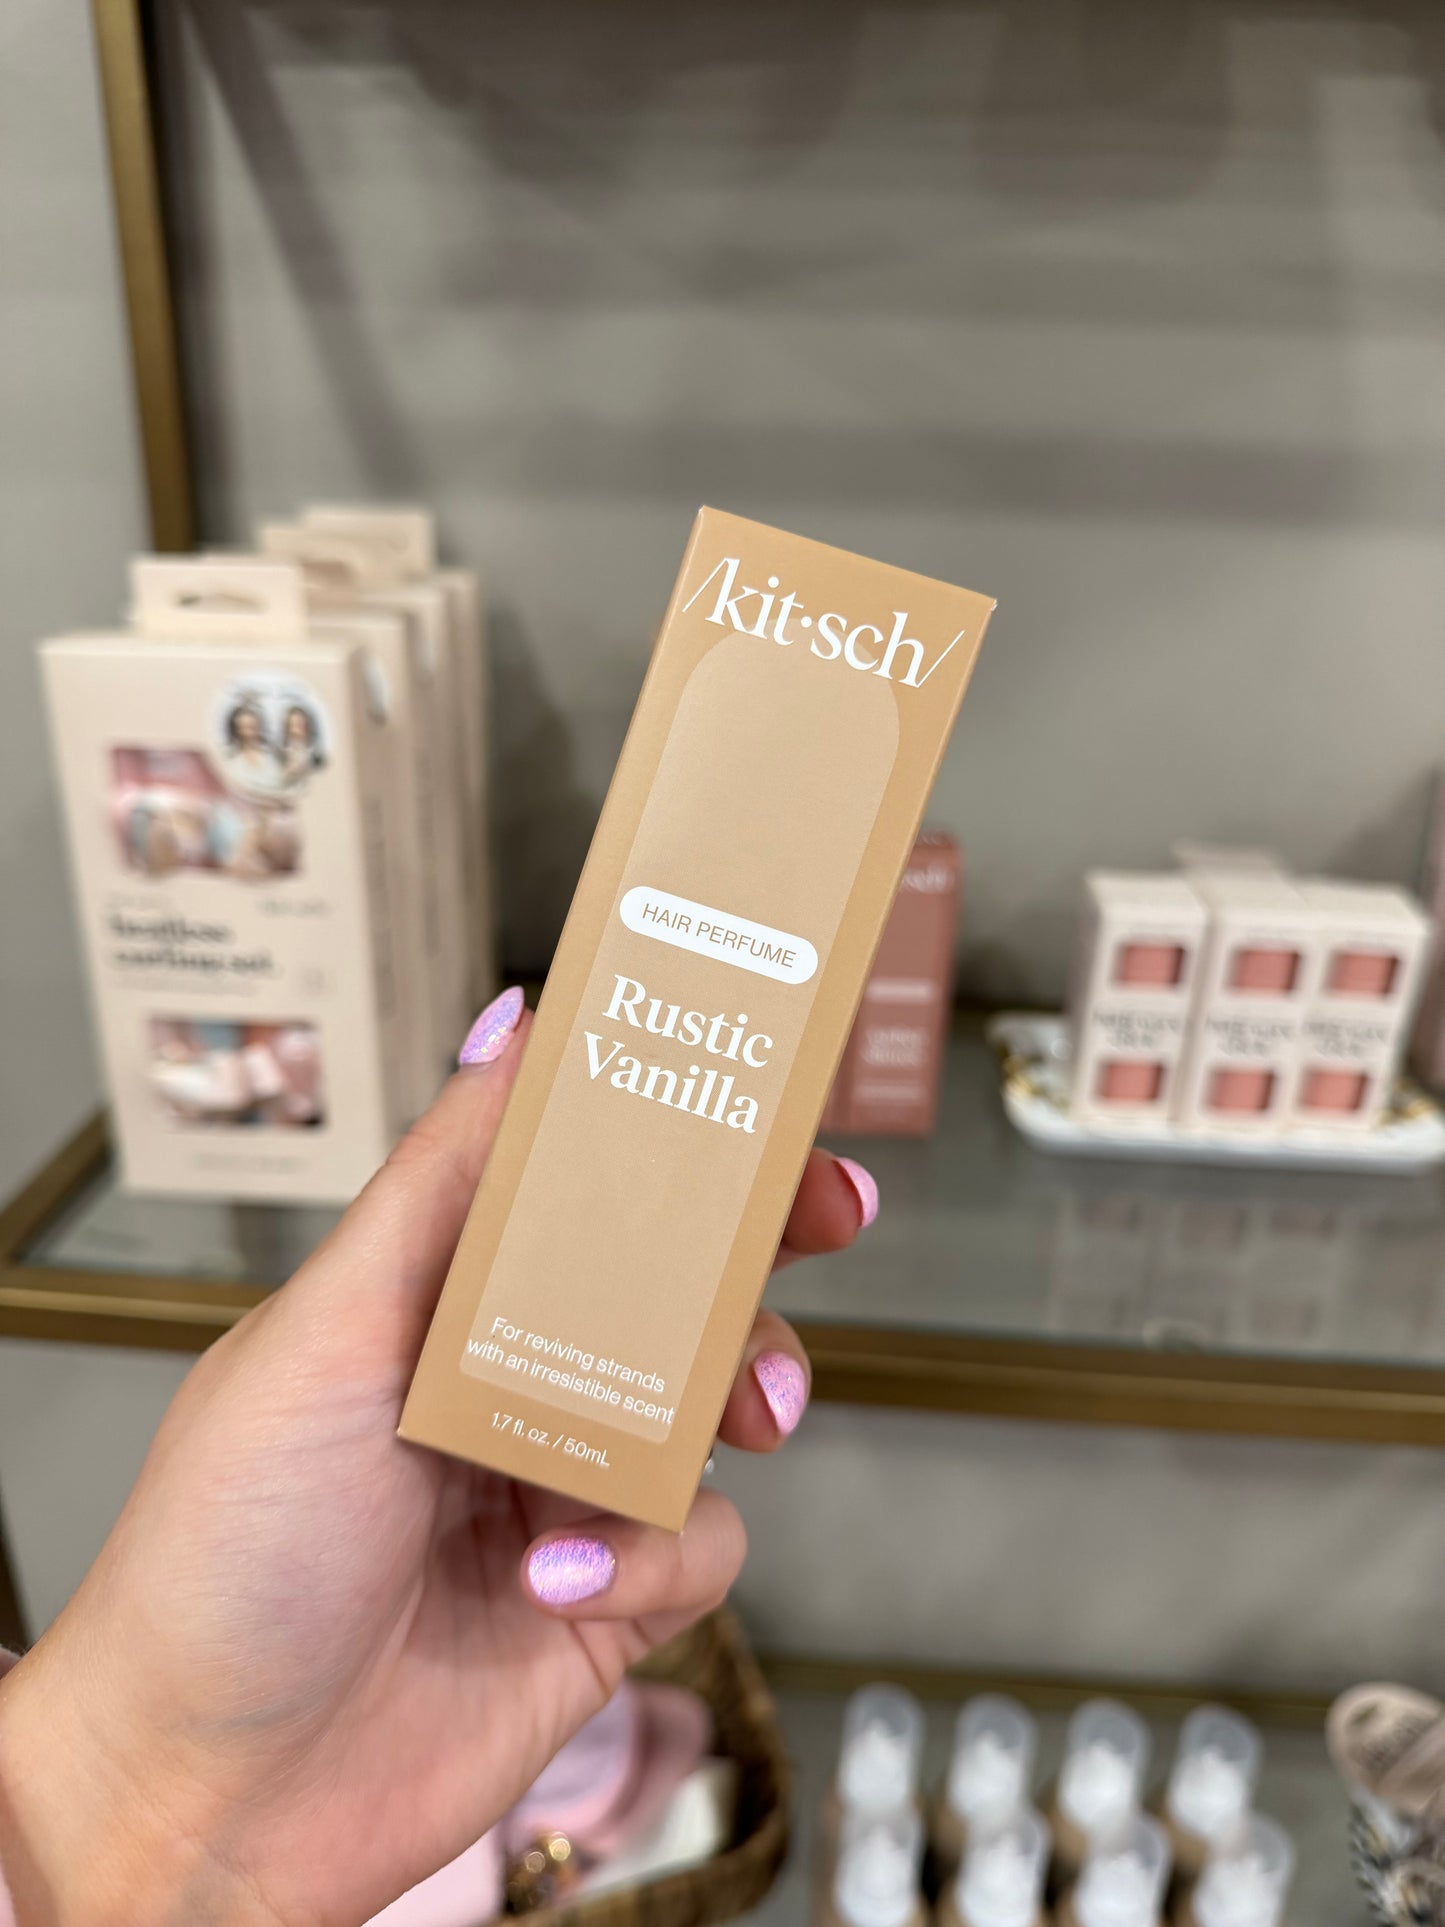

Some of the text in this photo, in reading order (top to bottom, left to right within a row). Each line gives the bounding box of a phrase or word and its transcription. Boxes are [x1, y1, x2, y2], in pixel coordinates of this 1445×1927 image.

[642, 903, 796, 968] HAIR PERFUME
[602, 974, 773, 1068] Rustic
[584, 1031, 759, 1133] Vanilla
[467, 1338, 675, 1424] with an irresistible scent
[491, 1316, 665, 1392] For reviving strands
[492, 1411, 513, 1430] 1.7
[513, 1419, 525, 1436] fl.
[528, 1428, 550, 1445] oz.
[564, 1437, 610, 1466] 50mL
